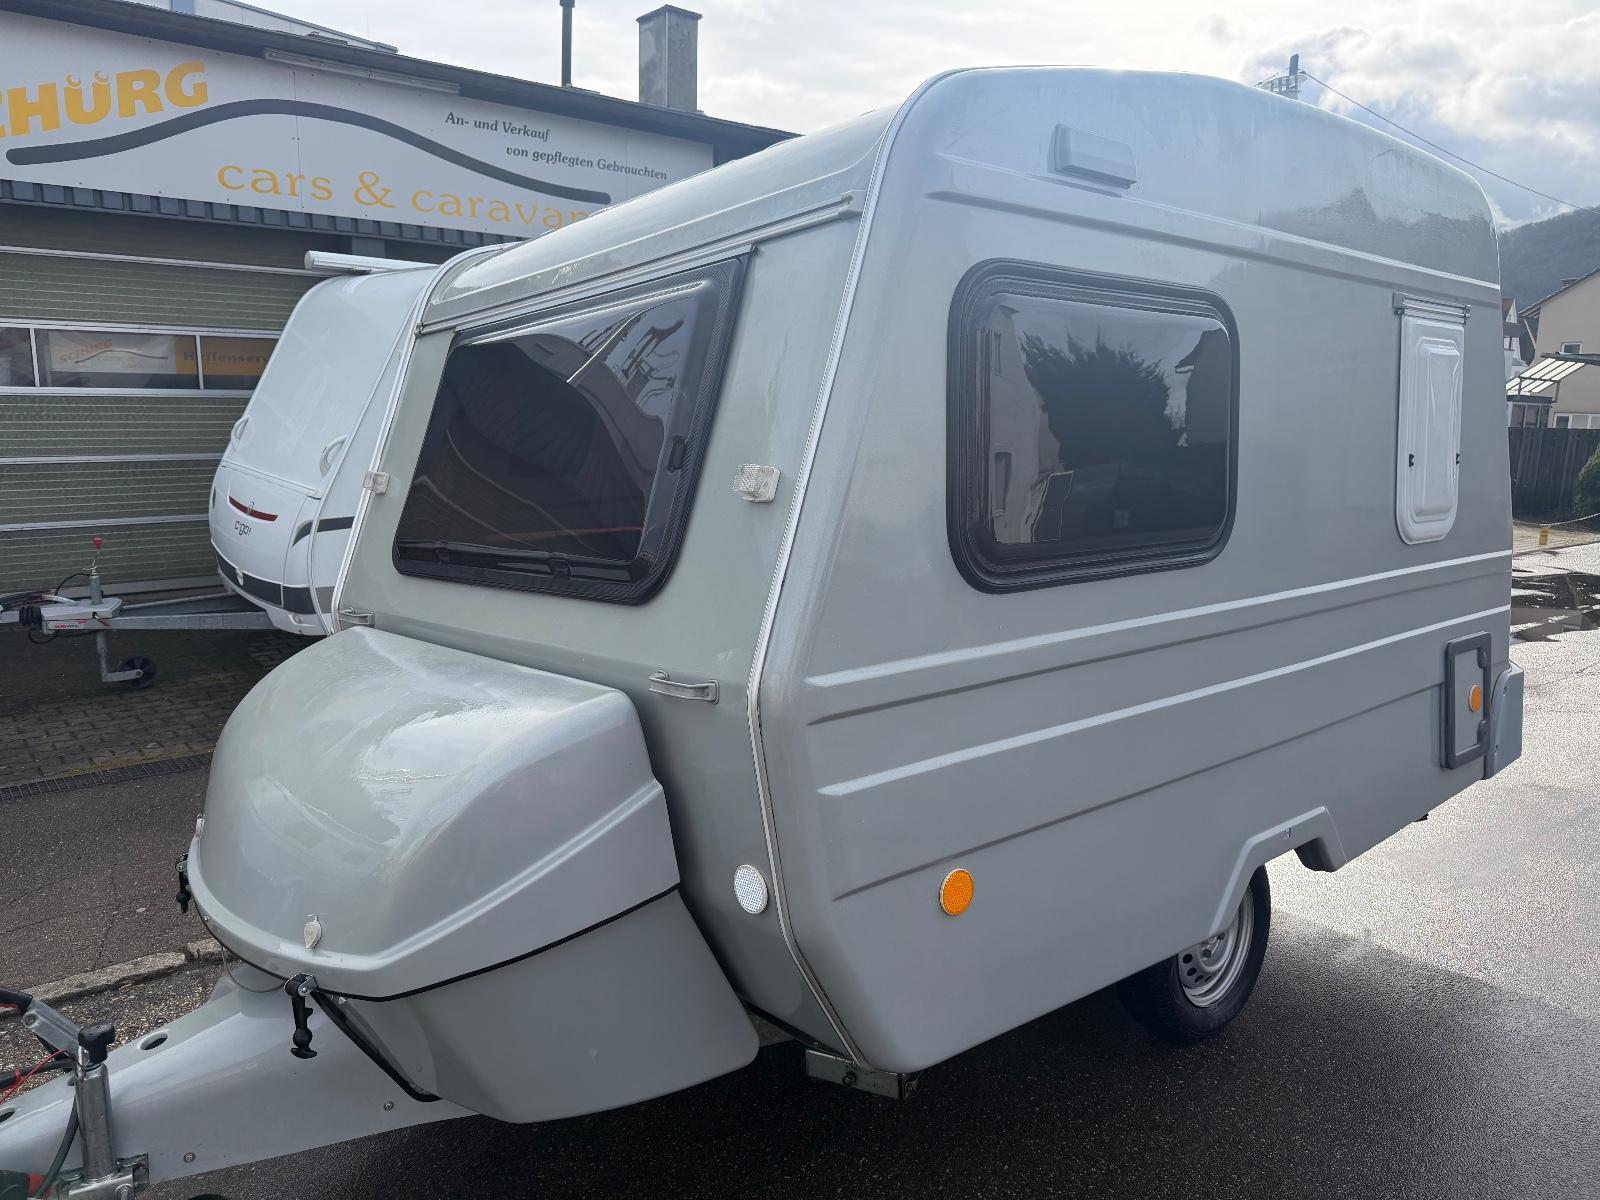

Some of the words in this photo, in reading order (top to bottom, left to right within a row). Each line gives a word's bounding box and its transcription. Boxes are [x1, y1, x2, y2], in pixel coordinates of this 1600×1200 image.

[0, 61, 209, 138] HÜRG
[445, 111, 470, 126] An-
[474, 120, 498, 132] und
[502, 121, 551, 142] Verkauf
[506, 146, 528, 158] von
[532, 151, 593, 168] gepflegten
[597, 158, 667, 180] Gebrauchten
[217, 165, 333, 201] cars
[354, 171, 395, 208] &
